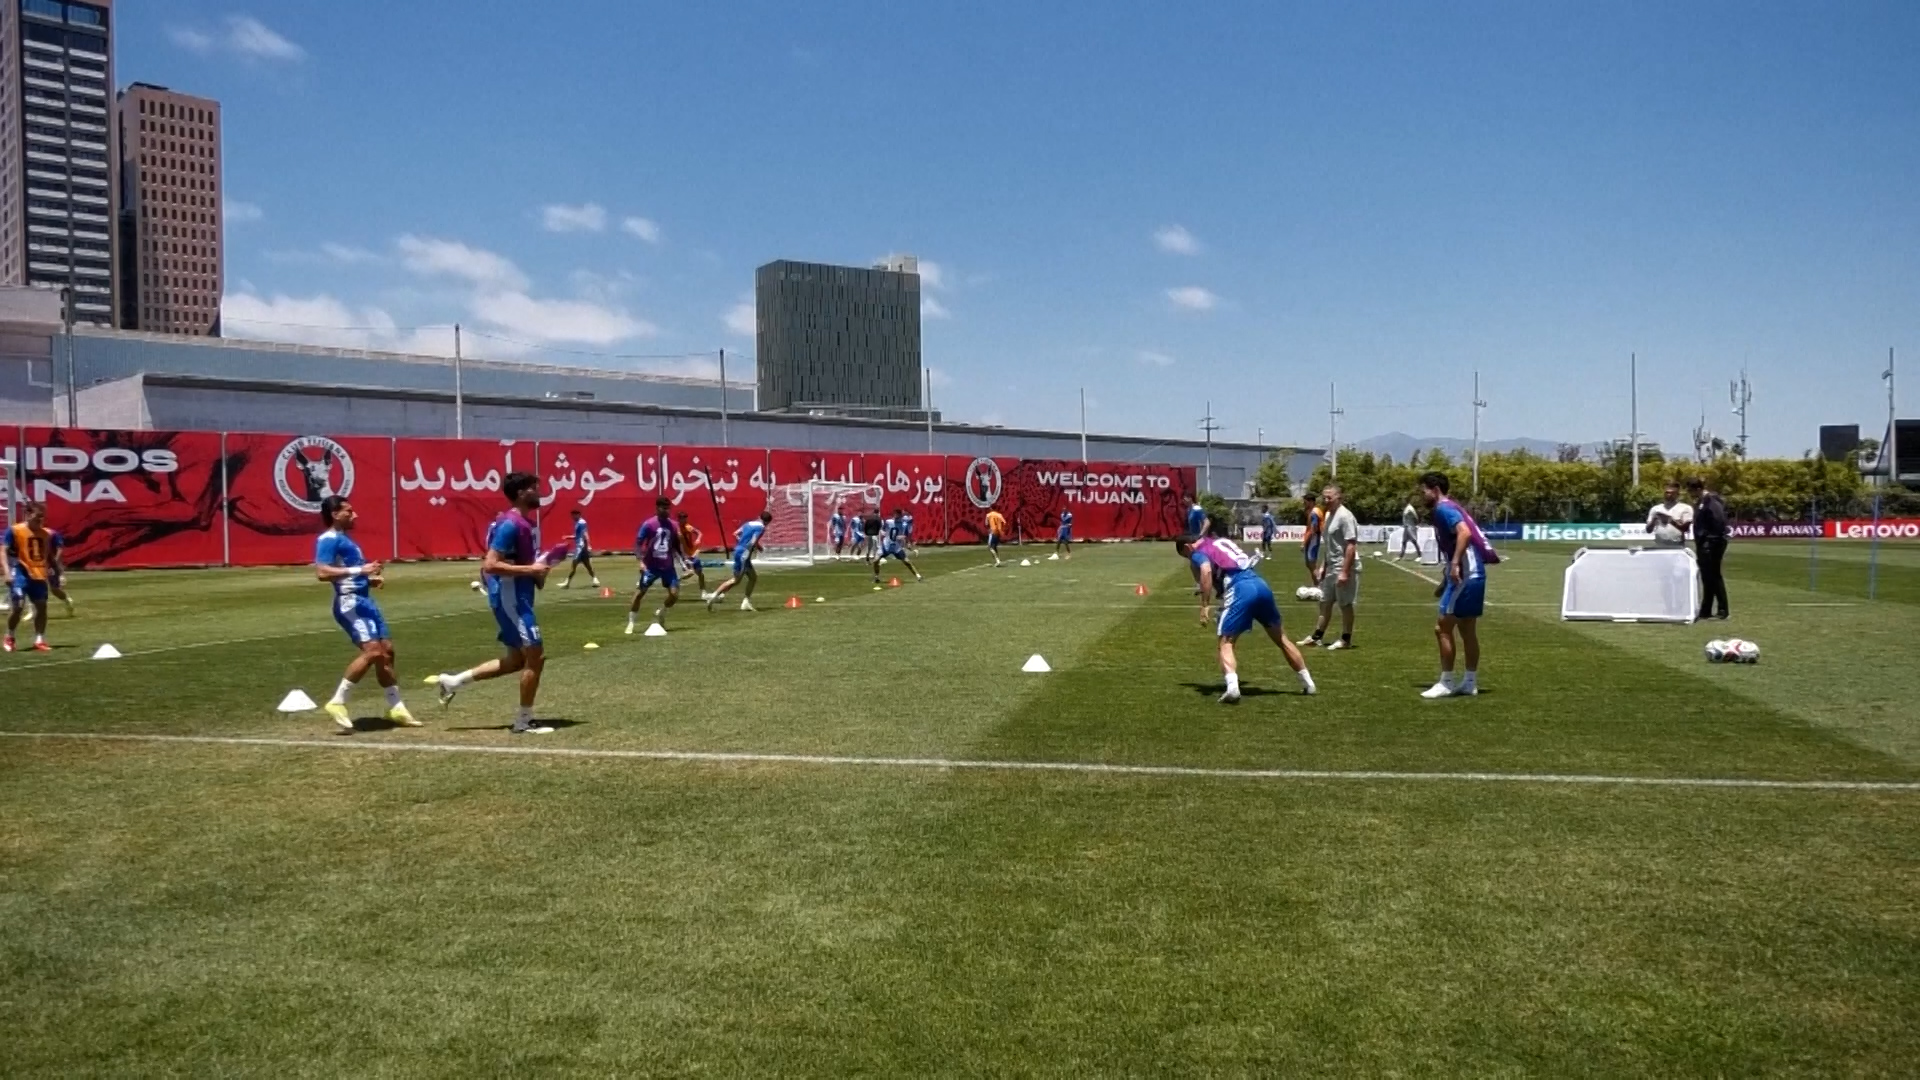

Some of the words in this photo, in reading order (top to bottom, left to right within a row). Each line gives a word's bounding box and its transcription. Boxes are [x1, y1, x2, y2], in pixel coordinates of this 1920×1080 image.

[399, 440, 516, 506] آمدید
[539, 452, 625, 506] خوش
[1036, 471, 1144, 489] WELCOME
[1146, 475, 1171, 489] TO
[1063, 488, 1147, 505] TIJUANA
[1522, 524, 1623, 540] Hisense
[1769, 524, 1824, 537] AIRWAYS
[1835, 521, 1920, 539] Lenovo
